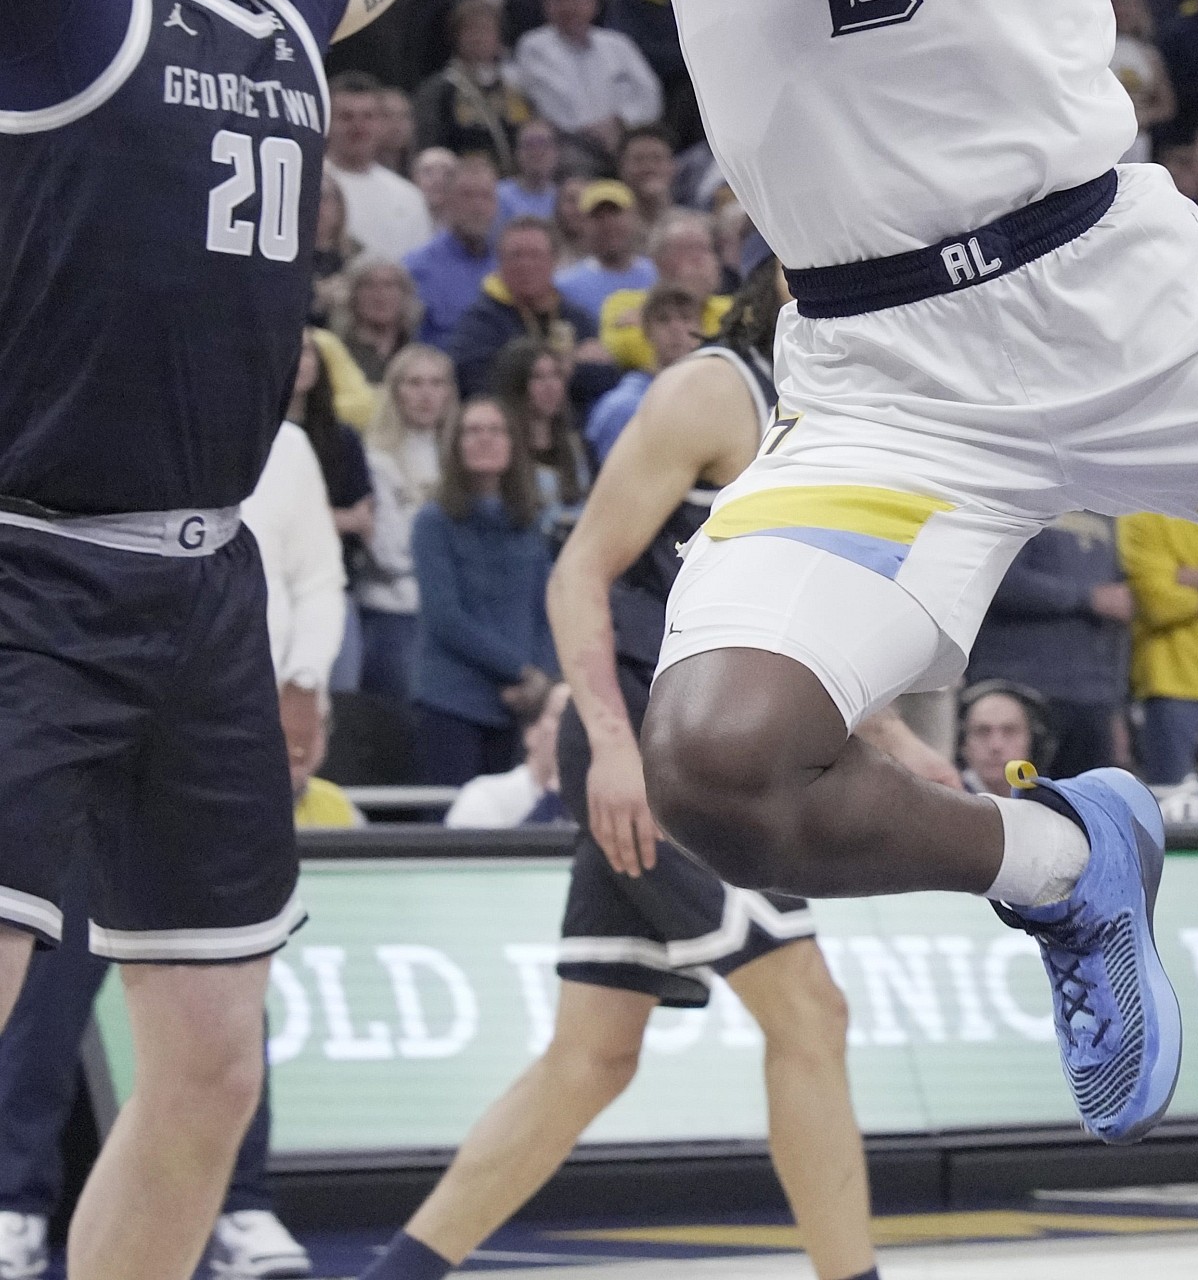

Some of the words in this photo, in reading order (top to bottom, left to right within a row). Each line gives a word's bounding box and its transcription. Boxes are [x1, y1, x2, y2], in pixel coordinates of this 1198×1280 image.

[206, 129, 303, 262] 20
[940, 236, 1003, 286] AL
[178, 516, 206, 550] G
